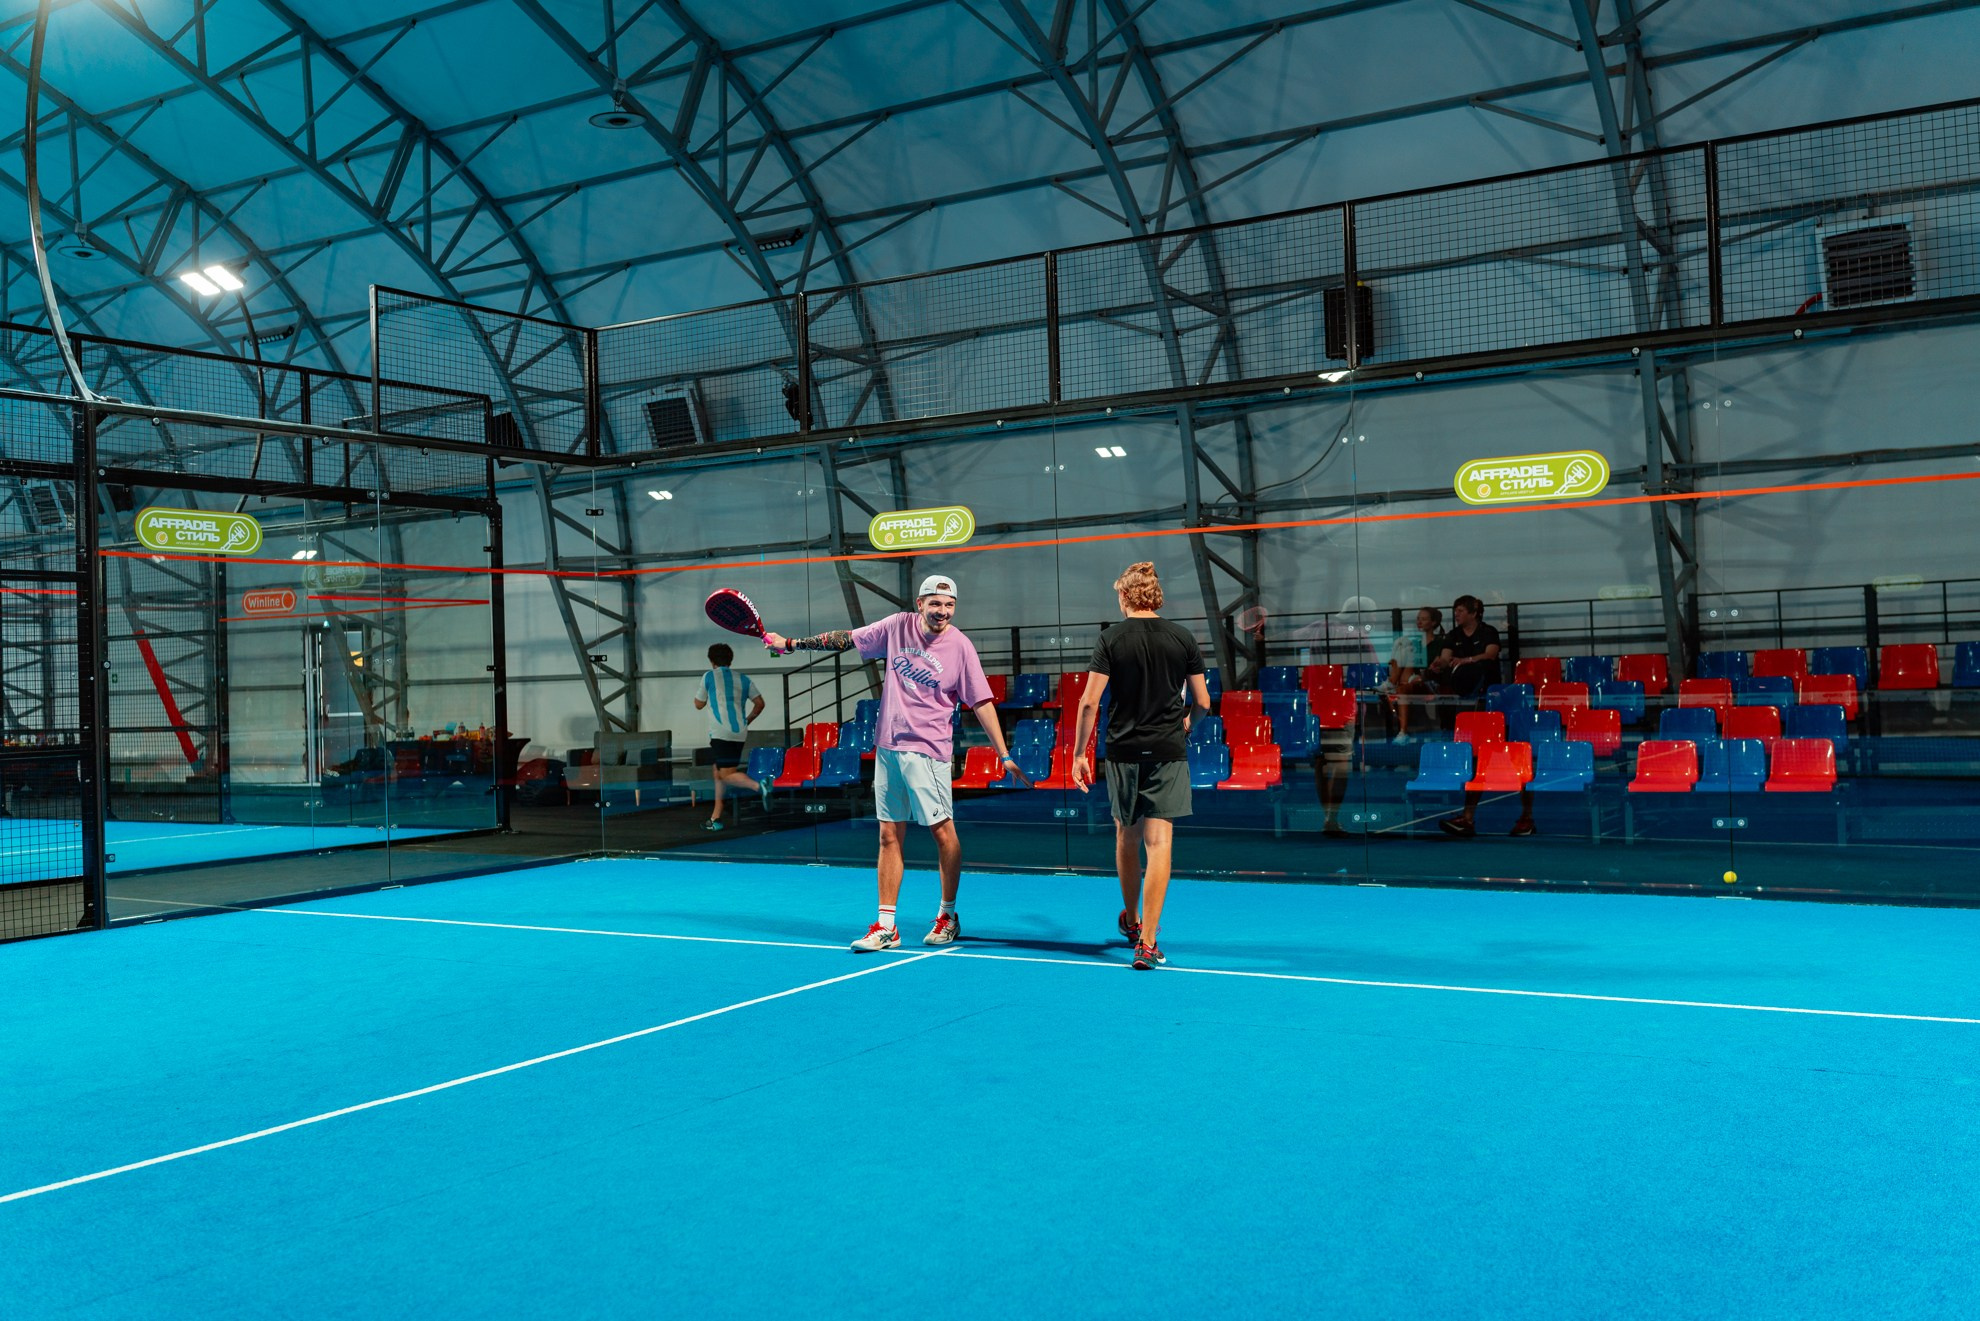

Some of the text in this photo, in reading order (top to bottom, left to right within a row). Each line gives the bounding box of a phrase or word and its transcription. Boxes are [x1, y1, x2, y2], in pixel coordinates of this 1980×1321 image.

[1468, 464, 1554, 482] AFFPADEL
[1499, 477, 1554, 490] СТИЛЬ
[148, 517, 220, 532] AFFPADEL
[878, 517, 937, 531] AFFPADEL
[175, 530, 220, 543] СТИЛЬ
[900, 527, 937, 539] СТИЛЬ
[248, 596, 281, 608] Winline
[737, 591, 760, 621] Wilson
[899, 647, 944, 674] PHILADELPHIA
[890, 655, 941, 689] Phillies
